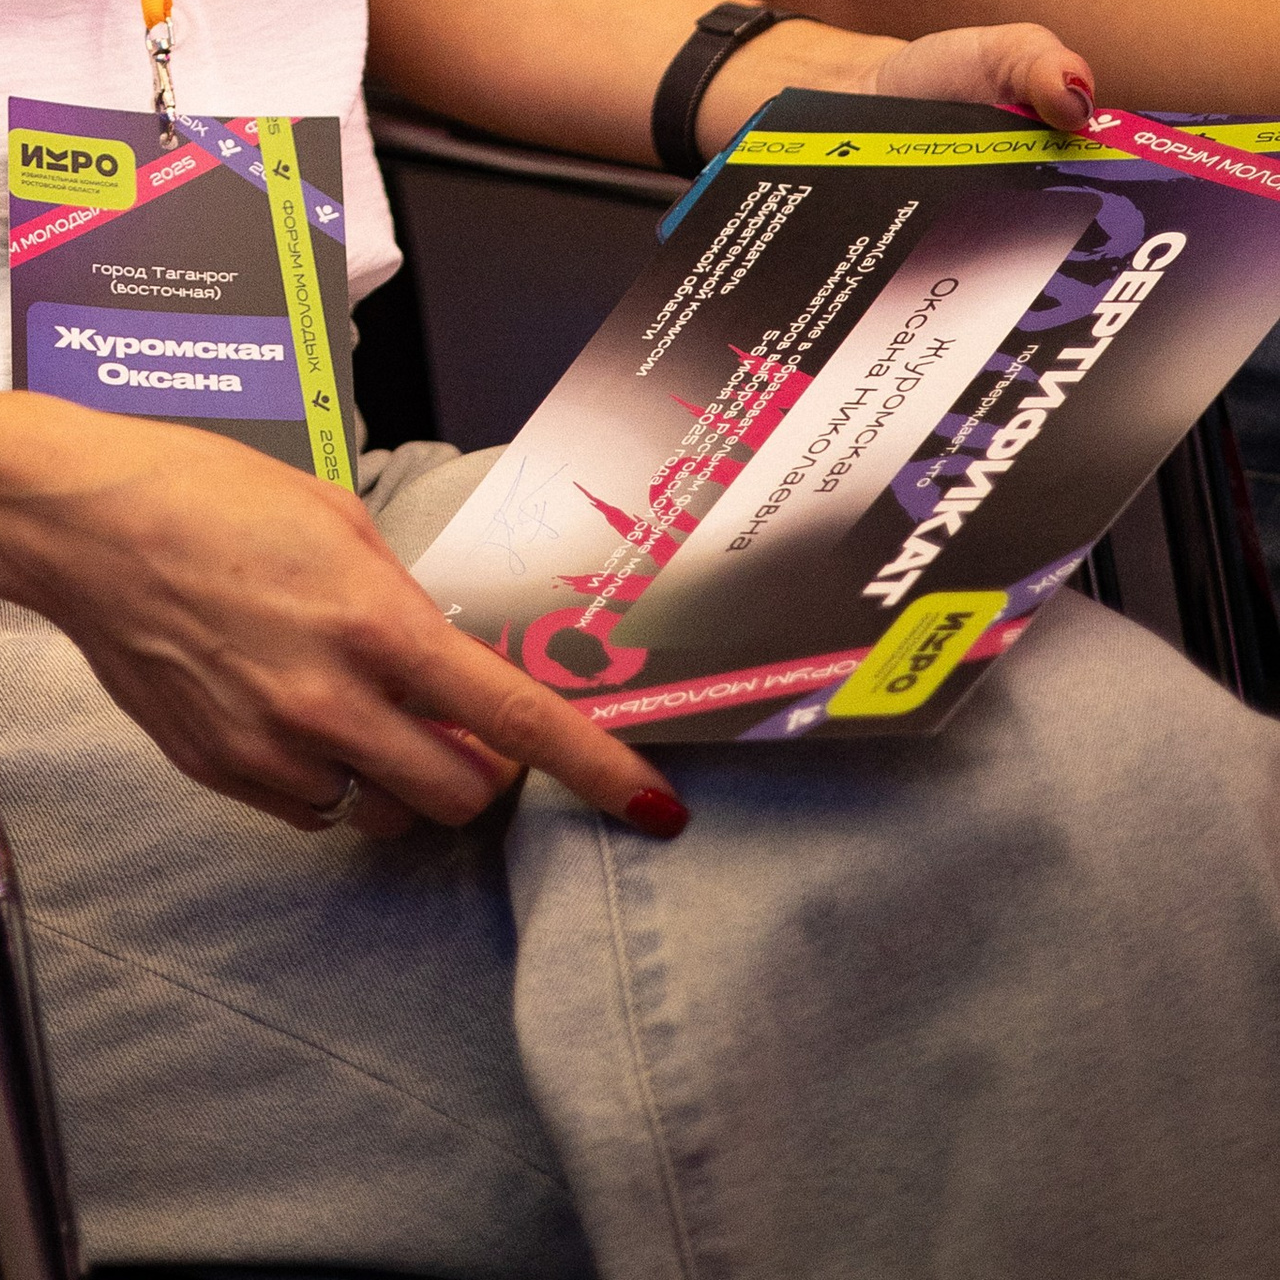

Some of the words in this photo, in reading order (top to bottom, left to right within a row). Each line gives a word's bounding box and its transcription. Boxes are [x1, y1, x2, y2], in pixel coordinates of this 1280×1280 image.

[885, 140, 1035, 155] МОЛОДЫХ
[1133, 131, 1221, 168] ФОРУМ
[1216, 159, 1280, 191] МОЛО
[20, 206, 108, 250] МОЛОДЫ
[149, 155, 197, 187] 2025
[691, 181, 773, 272] Ростовской
[693, 184, 792, 299] Избирательной
[717, 185, 813, 294] Председатель
[858, 200, 919, 272] принял(а)
[92, 263, 148, 280] город
[152, 266, 239, 284] Таганрог
[110, 279, 222, 300] (восточная)
[774, 236, 868, 350] организаторов
[634, 301, 700, 376] комиссии
[640, 275, 696, 339] области
[806, 276, 862, 338] участие
[863, 276, 957, 378] Оксана
[54, 325, 285, 361] Журомская
[282, 199, 303, 269] ФОРУМ
[295, 273, 322, 373] МОЛОДЫХ
[320, 429, 340, 482] 2025
[748, 329, 781, 357] 5-6
[795, 341, 813, 352] в
[97, 362, 243, 391] Оксана
[714, 359, 756, 400] июня
[721, 353, 781, 419] выборов
[936, 343, 1039, 458] подтверждает,
[679, 402, 724, 446] 2025
[686, 354, 802, 490] образовательном
[811, 338, 956, 493] Журомская
[859, 231, 1188, 608] СЕРТИФИКАТ
[644, 422, 731, 516] Ростовской
[646, 448, 685, 485] года
[725, 388, 878, 552] Николаевна
[913, 458, 947, 488] что
[586, 521, 647, 587] области
[636, 494, 690, 553] форуме
[573, 557, 641, 628] молодых
[591, 677, 757, 720] МОЛОДЫХ
[764, 659, 861, 689] ОРУМ
